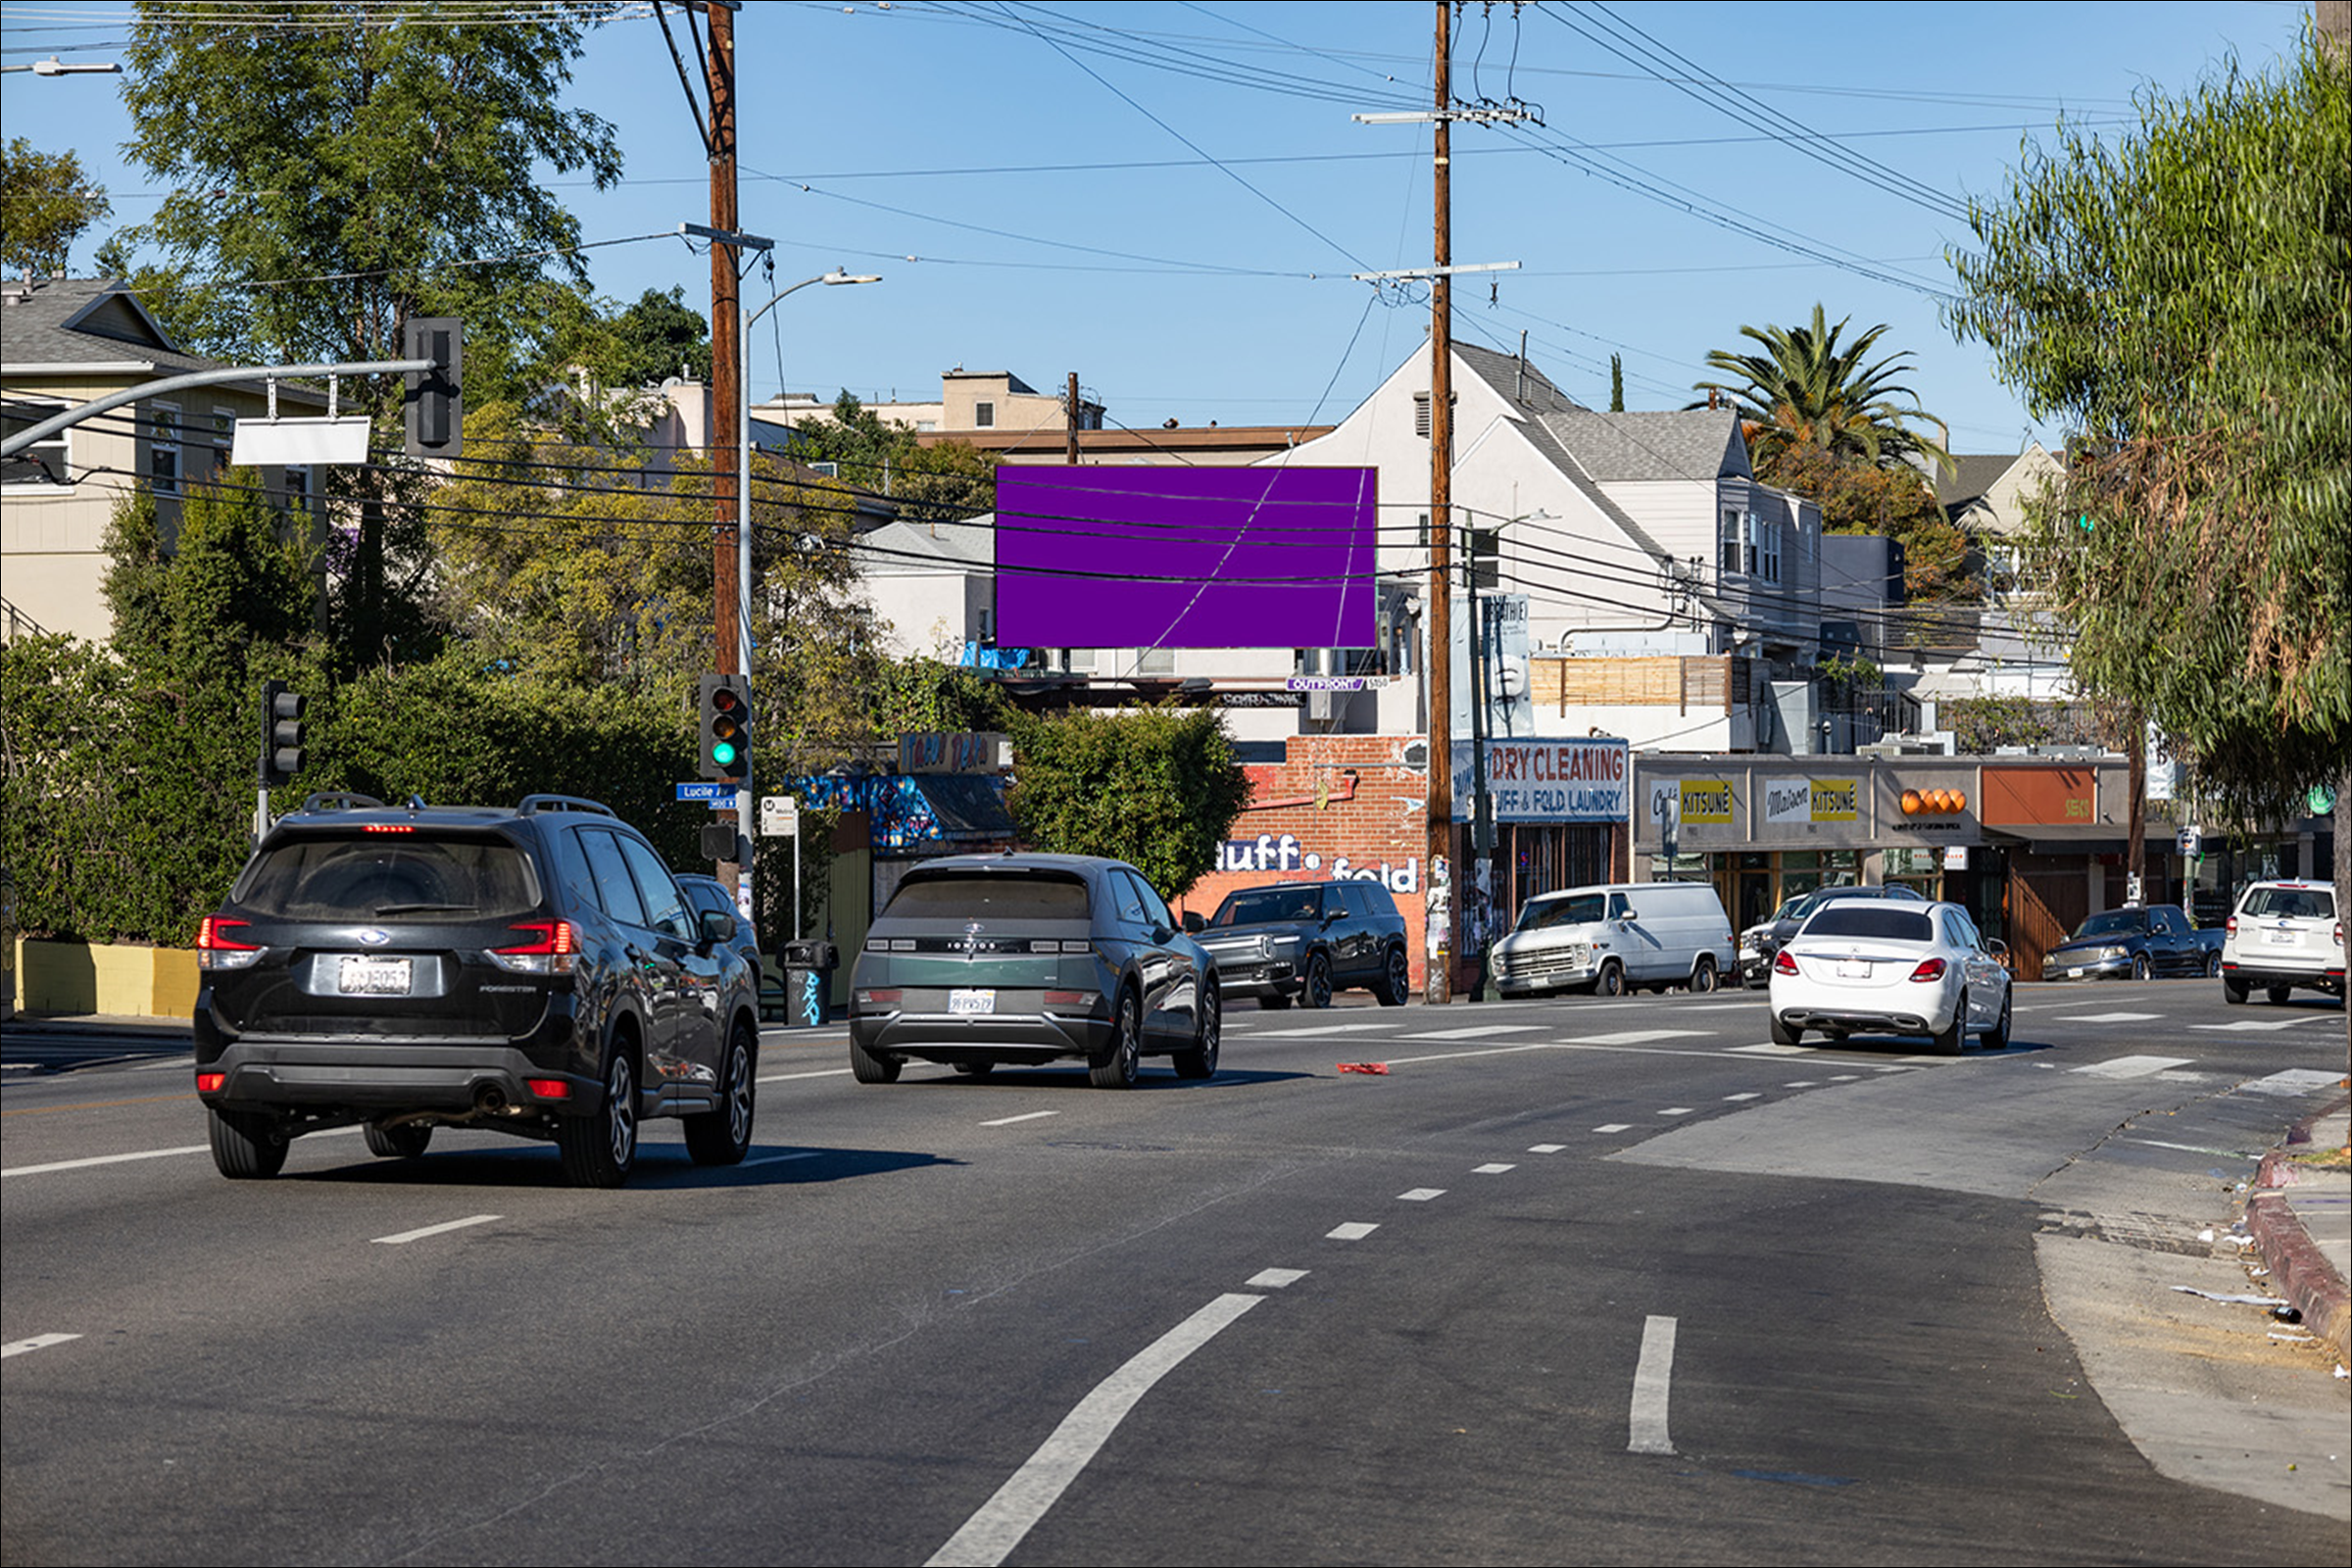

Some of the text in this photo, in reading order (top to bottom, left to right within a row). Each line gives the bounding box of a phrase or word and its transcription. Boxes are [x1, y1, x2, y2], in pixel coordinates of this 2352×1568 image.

[1294, 678, 1355, 690] OUTFRONT
[1492, 747, 1624, 782] DRY CLEANING
[683, 786, 713, 798] Lucile
[1492, 790, 1518, 812] UFF
[1534, 791, 1565, 812] FOLD
[1569, 790, 1622, 812] LAUNDRY
[1683, 785, 1730, 814] KITSUNÉ
[1767, 784, 1856, 817] Maison KITSUNÉ
[1216, 833, 1298, 870] luff
